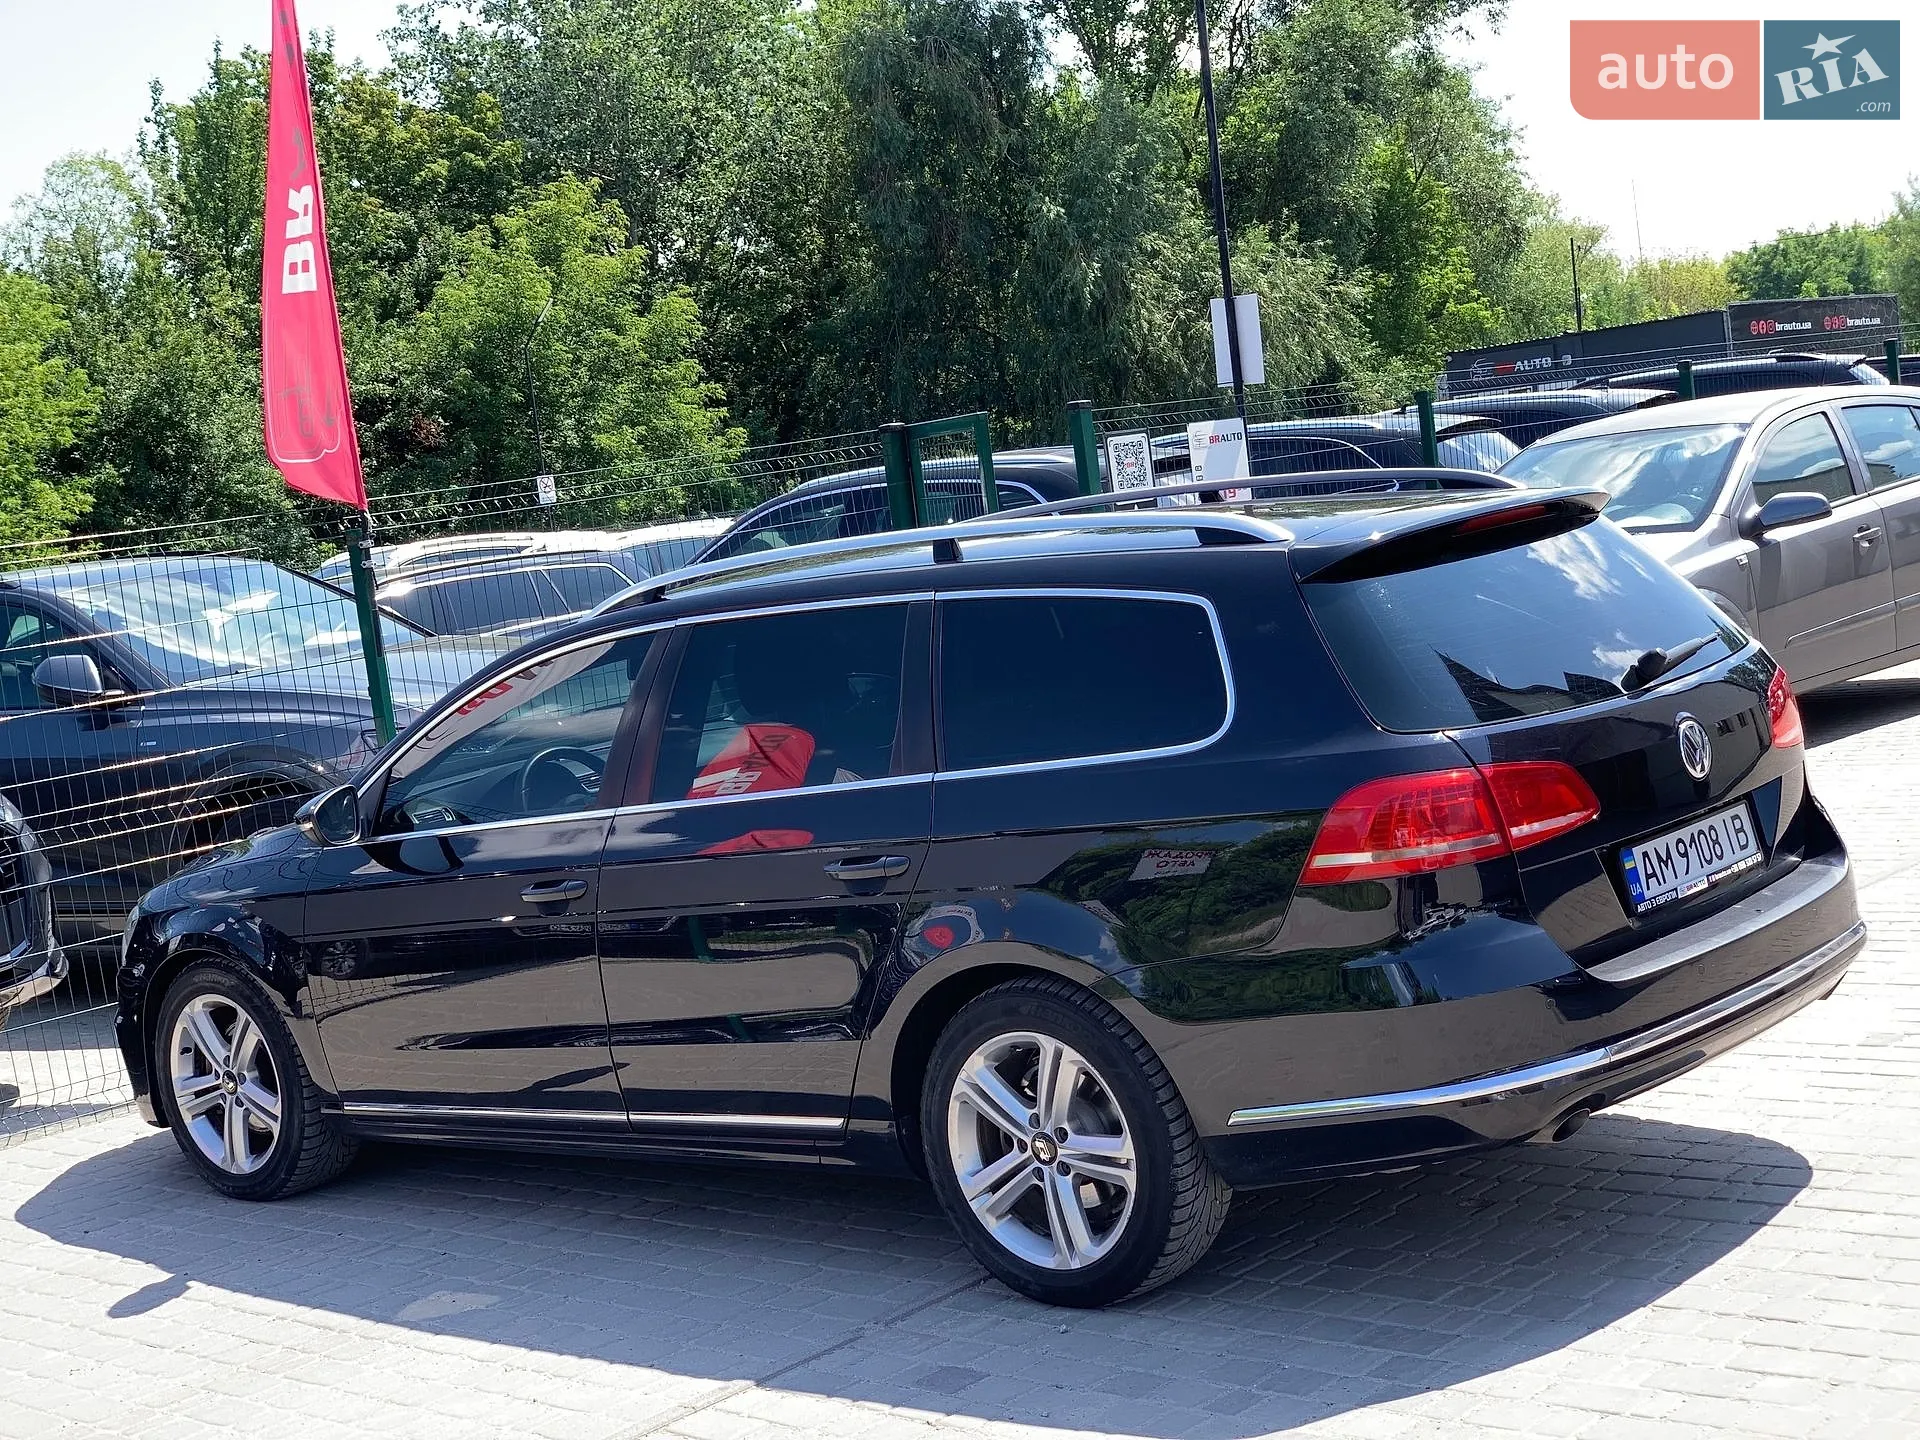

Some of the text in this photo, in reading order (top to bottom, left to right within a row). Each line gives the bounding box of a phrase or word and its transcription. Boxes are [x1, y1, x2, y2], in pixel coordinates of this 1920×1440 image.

[1774, 320, 1812, 332] brauto.ua
[1846, 316, 1881, 327] brauto.ua
[1208, 431, 1243, 444] BRAUTO
[1641, 842, 1679, 892] AM
[1675, 824, 1724, 876] 9108
[1722, 813, 1749, 855] IB
[1630, 882, 1643, 896] UA
[1637, 900, 1652, 913] АВТО
